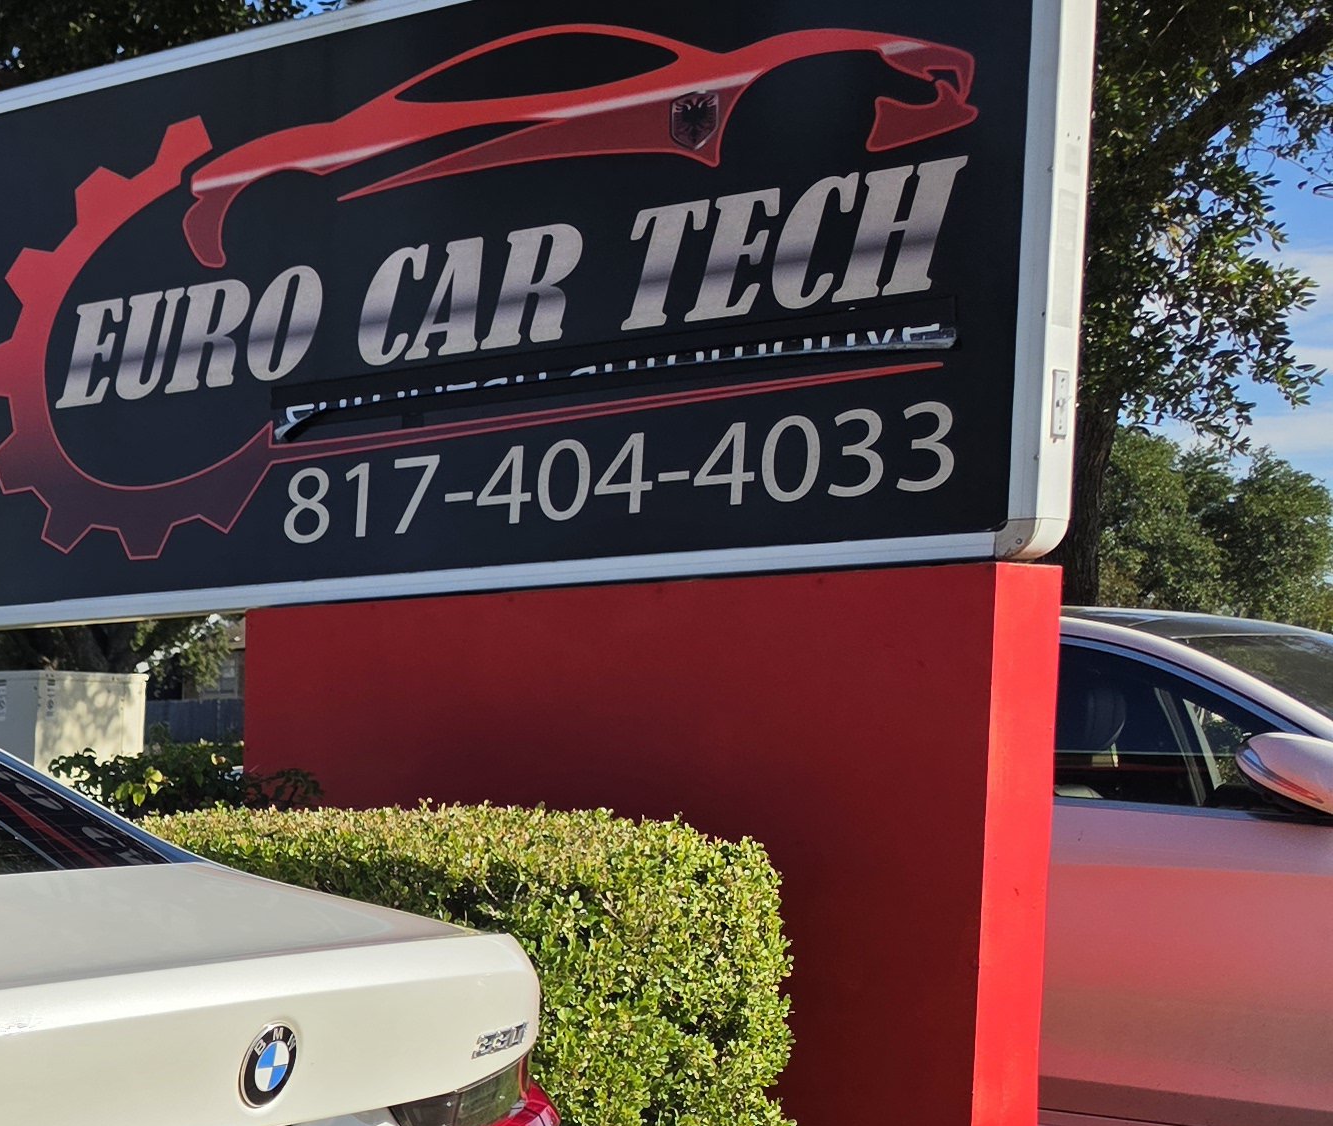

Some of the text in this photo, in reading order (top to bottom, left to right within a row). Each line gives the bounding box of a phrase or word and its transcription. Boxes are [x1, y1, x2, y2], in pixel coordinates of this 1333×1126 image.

[55, 265, 324, 409] EURO
[357, 223, 583, 366] CAR
[620, 155, 969, 331] TECH
[283, 401, 955, 544] 817-404-4033
[254, 1027, 296, 1055] BMW
